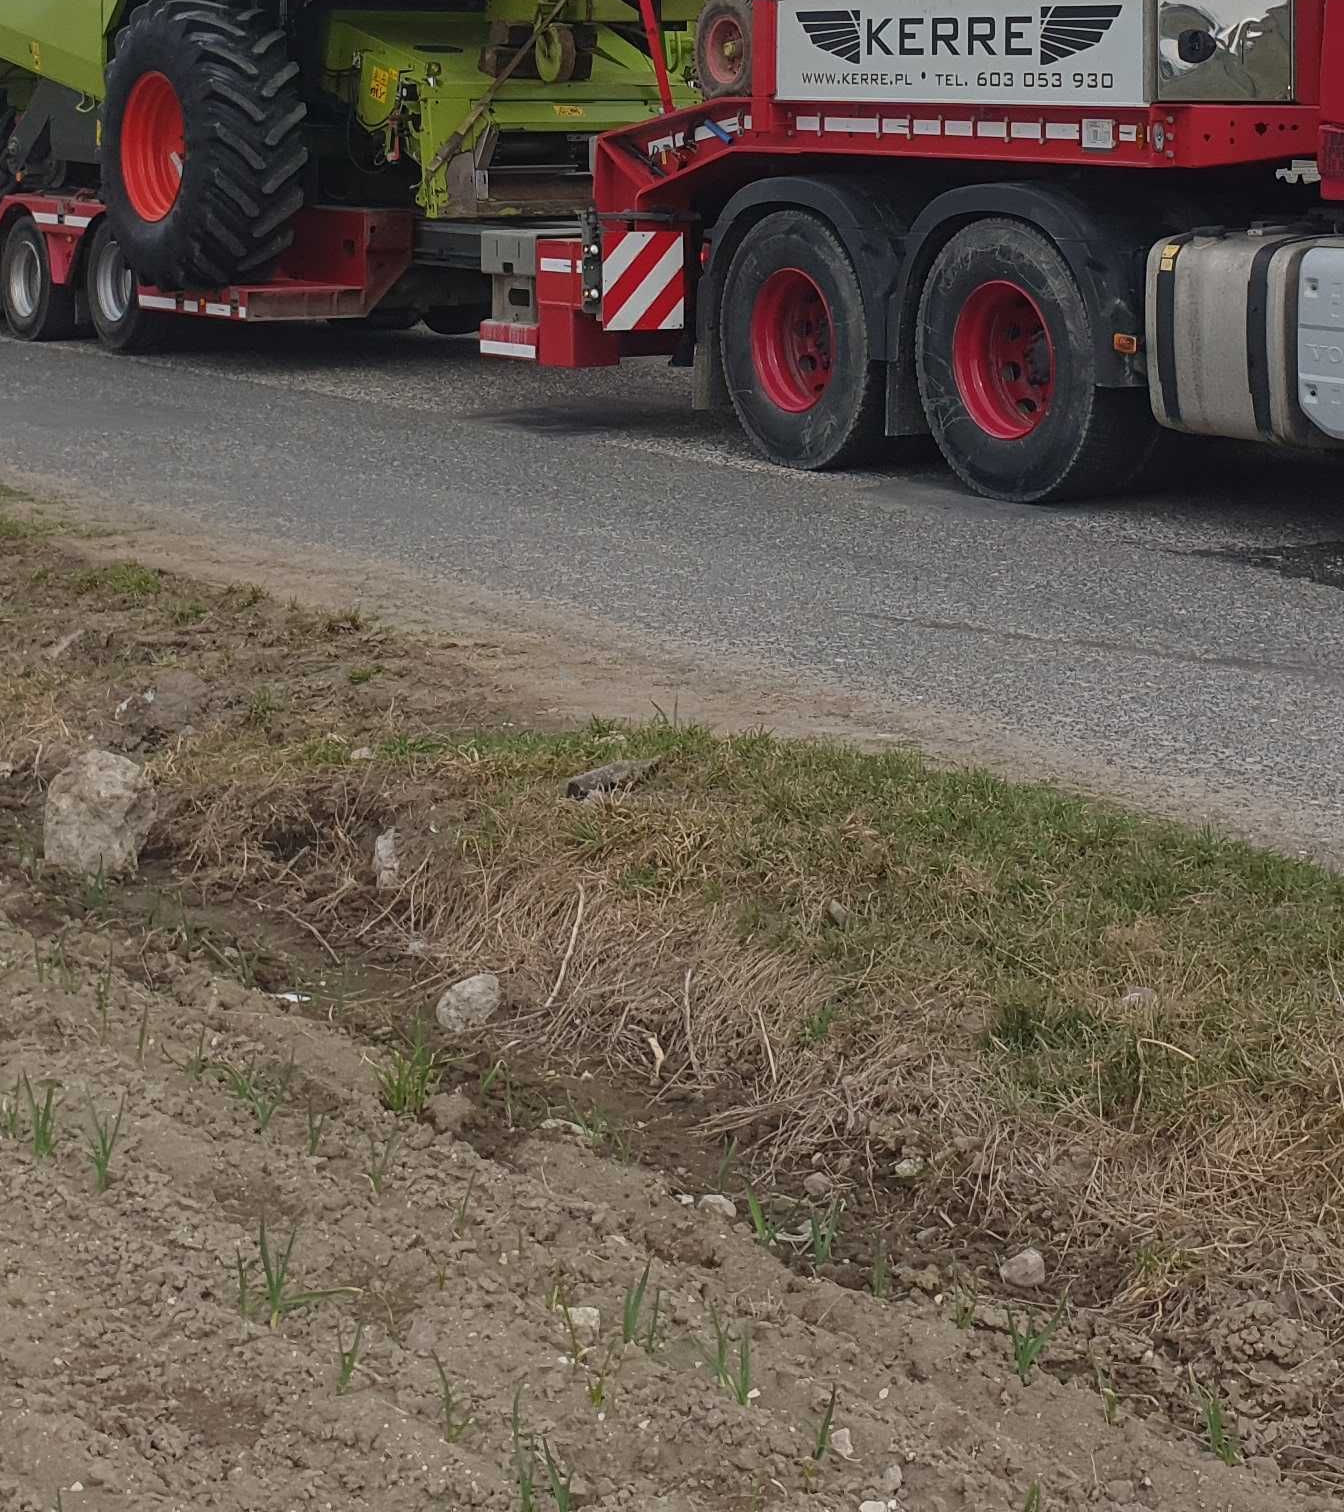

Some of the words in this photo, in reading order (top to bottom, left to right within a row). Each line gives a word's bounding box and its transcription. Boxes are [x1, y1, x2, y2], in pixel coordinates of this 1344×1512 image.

[866, 16, 1033, 56] KERRE
[801, 72, 913, 86] WWW.KERRE.PL
[935, 73, 968, 87] TEL.
[976, 72, 1014, 87] 603
[1023, 72, 1063, 88] 053
[1072, 73, 1113, 88] 930
